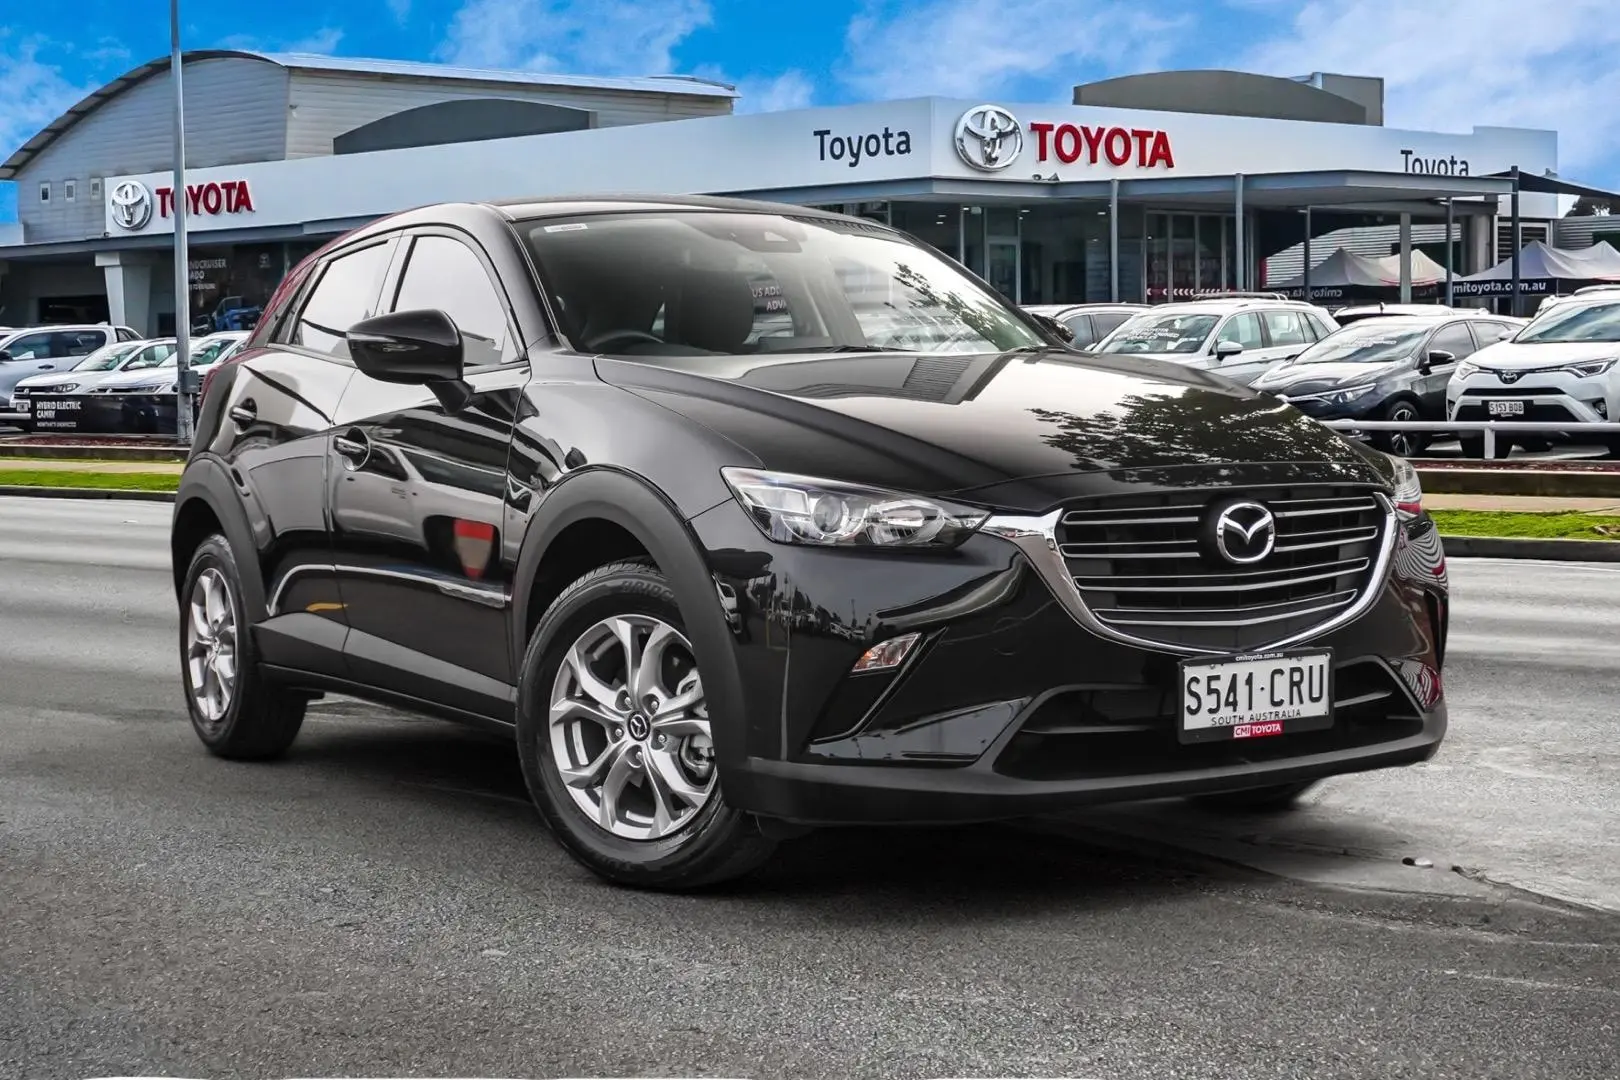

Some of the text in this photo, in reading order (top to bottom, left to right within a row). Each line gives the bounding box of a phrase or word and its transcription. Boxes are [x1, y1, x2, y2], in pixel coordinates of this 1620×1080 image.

[813, 127, 912, 167] Toyota
[1030, 122, 1175, 168] TOYOTA
[1453, 281, 1546, 294] mitoyota.cm.au
[57, 401, 81, 410] ELECTRIC
[620, 580, 678, 602] BRIDG
[1235, 652, 1284, 661] cmitoyota.com.au
[1211, 709, 1302, 726] SOUTH AUSTRALIA
[1235, 723, 1281, 736] CMI TOYOTA
